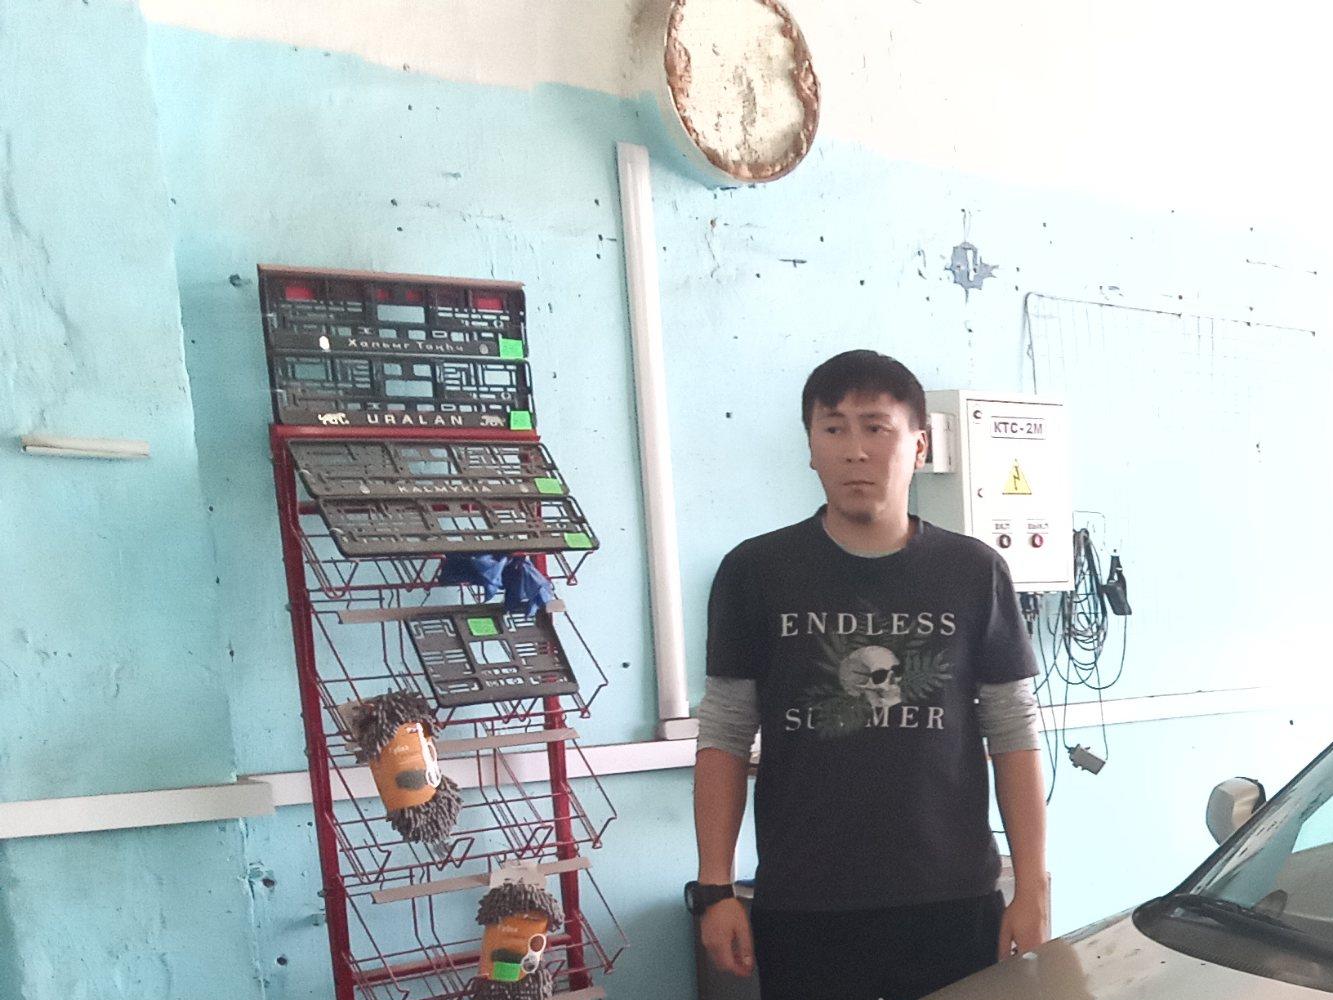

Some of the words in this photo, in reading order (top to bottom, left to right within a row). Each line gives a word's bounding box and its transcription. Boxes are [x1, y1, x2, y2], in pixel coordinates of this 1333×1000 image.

[366, 413, 463, 426] URALAN
[398, 484, 493, 494] KALMYKIA
[780, 612, 957, 637] ENDLESS
[785, 705, 945, 731] SMER
